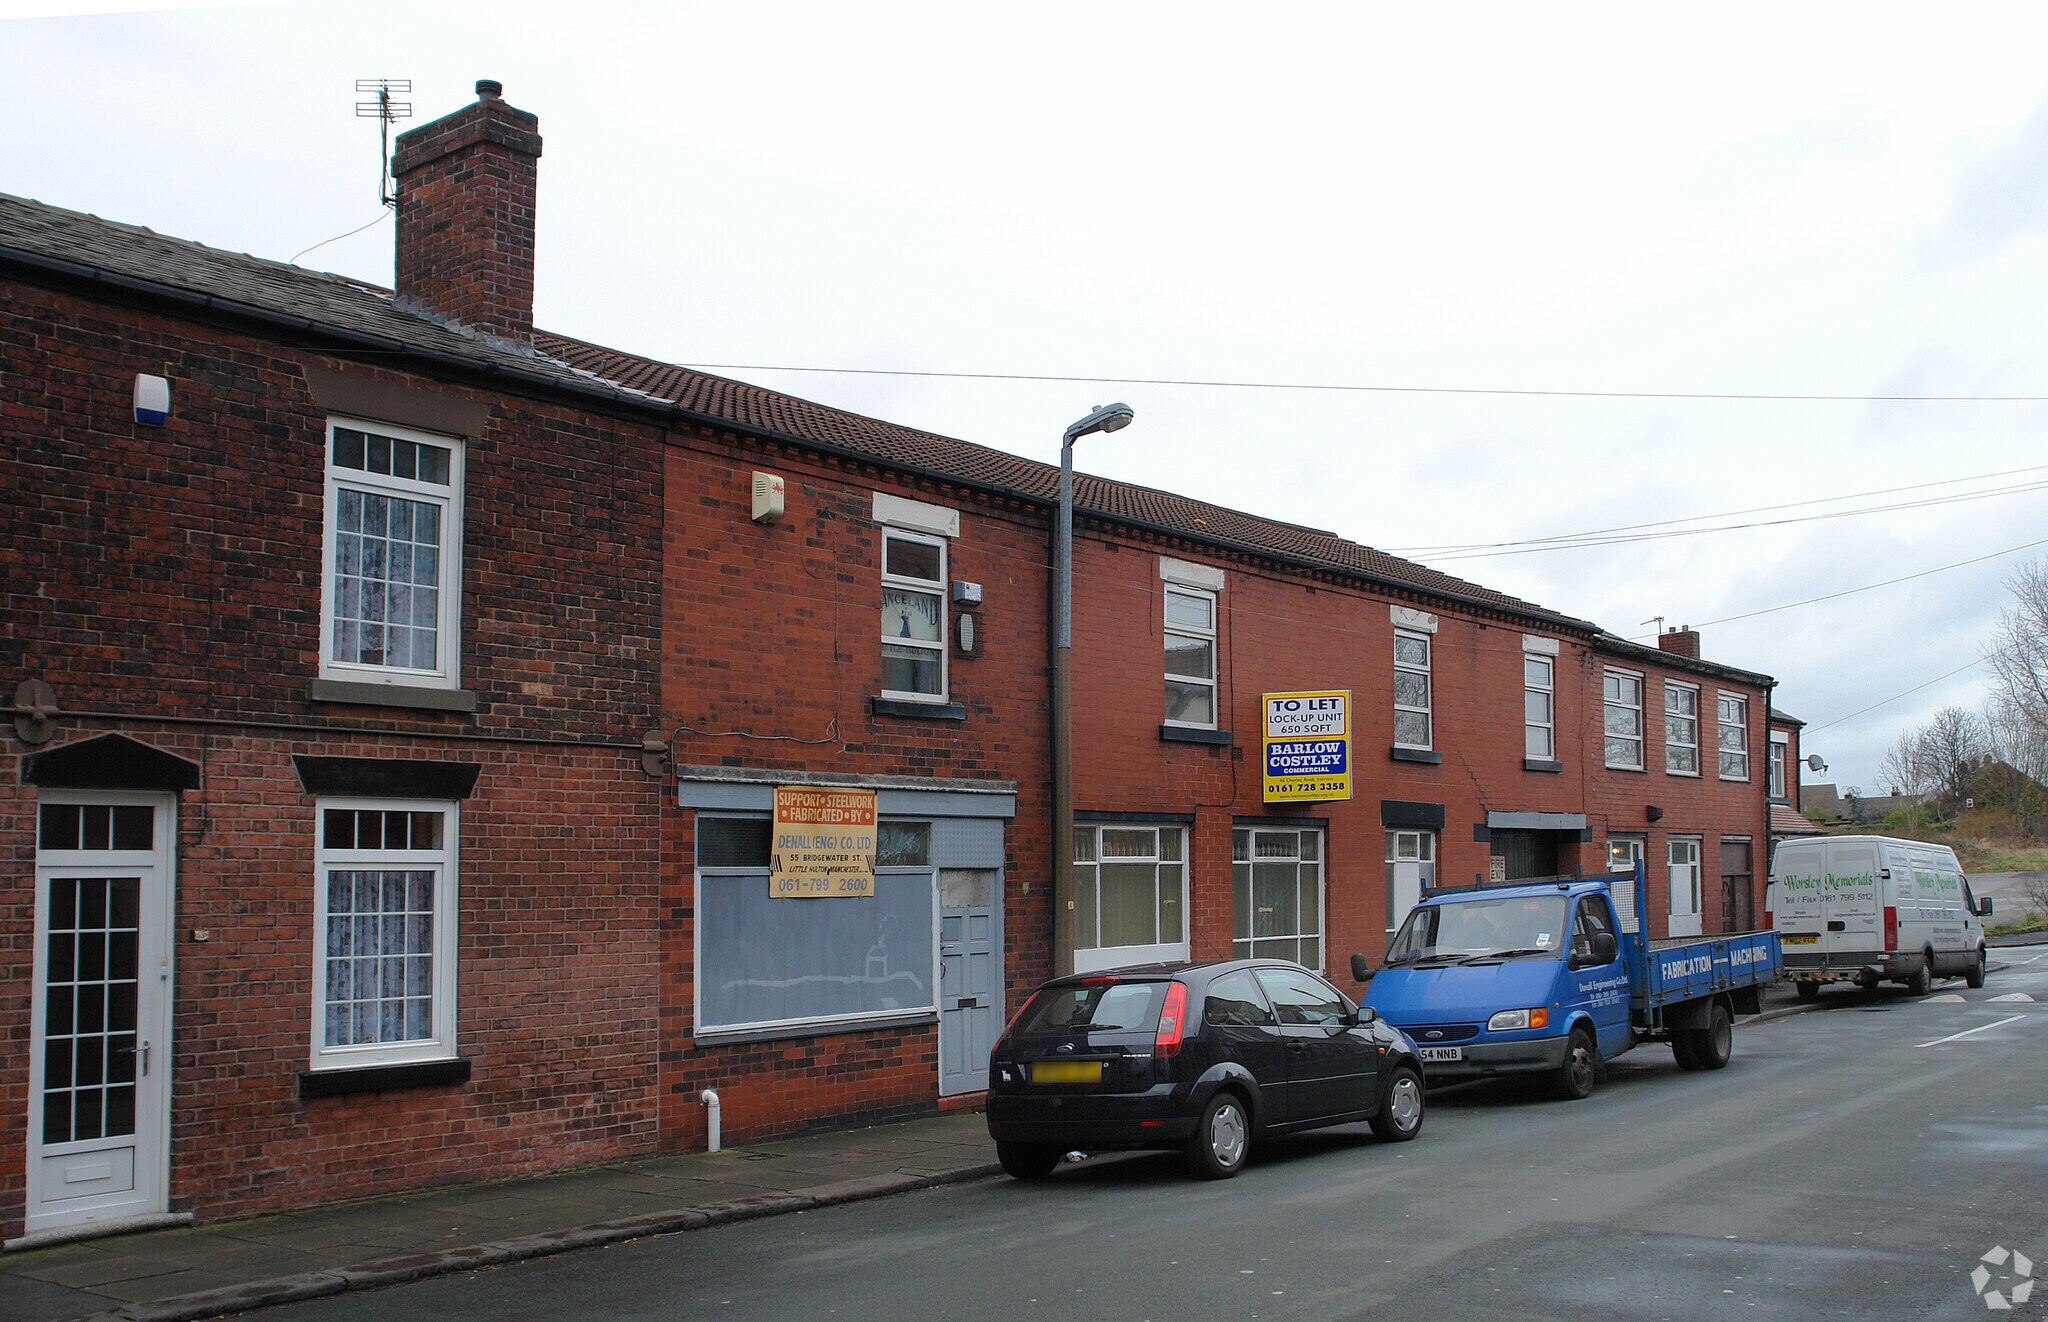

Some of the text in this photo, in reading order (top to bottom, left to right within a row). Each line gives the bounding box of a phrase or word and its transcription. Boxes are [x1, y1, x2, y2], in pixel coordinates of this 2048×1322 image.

[1273, 699, 1340, 712] TO LET
[1269, 713, 1343, 723] LOCK-UP UNIT
[1281, 724, 1332, 734] 650 SQFT
[1271, 742, 1341, 755] BARLOW
[1269, 754, 1342, 767] COSTLEY
[1268, 782, 1345, 793] 0161 728 3358
[779, 792, 873, 809] SUPPORT STEELWORK
[790, 808, 863, 823] FABRICATED BY
[840, 836, 855, 849] CO.
[857, 837, 871, 850] LTD
[790, 854, 862, 862] 55 BRIDGEWATER ST.
[778, 878, 868, 891] 061-799 2600
[1784, 874, 1821, 895] Worsley
[1824, 871, 1873, 891] Memorials
[1784, 896, 1795, 904] Tel
[1802, 895, 1817, 903] Fax
[1820, 894, 1836, 902] 0161
[1839, 893, 1855, 901] 799
[1857, 892, 1874, 900] 5112
[1661, 955, 1712, 981] FABRICATION
[1421, 1049, 1457, 1060] 54 NNB
